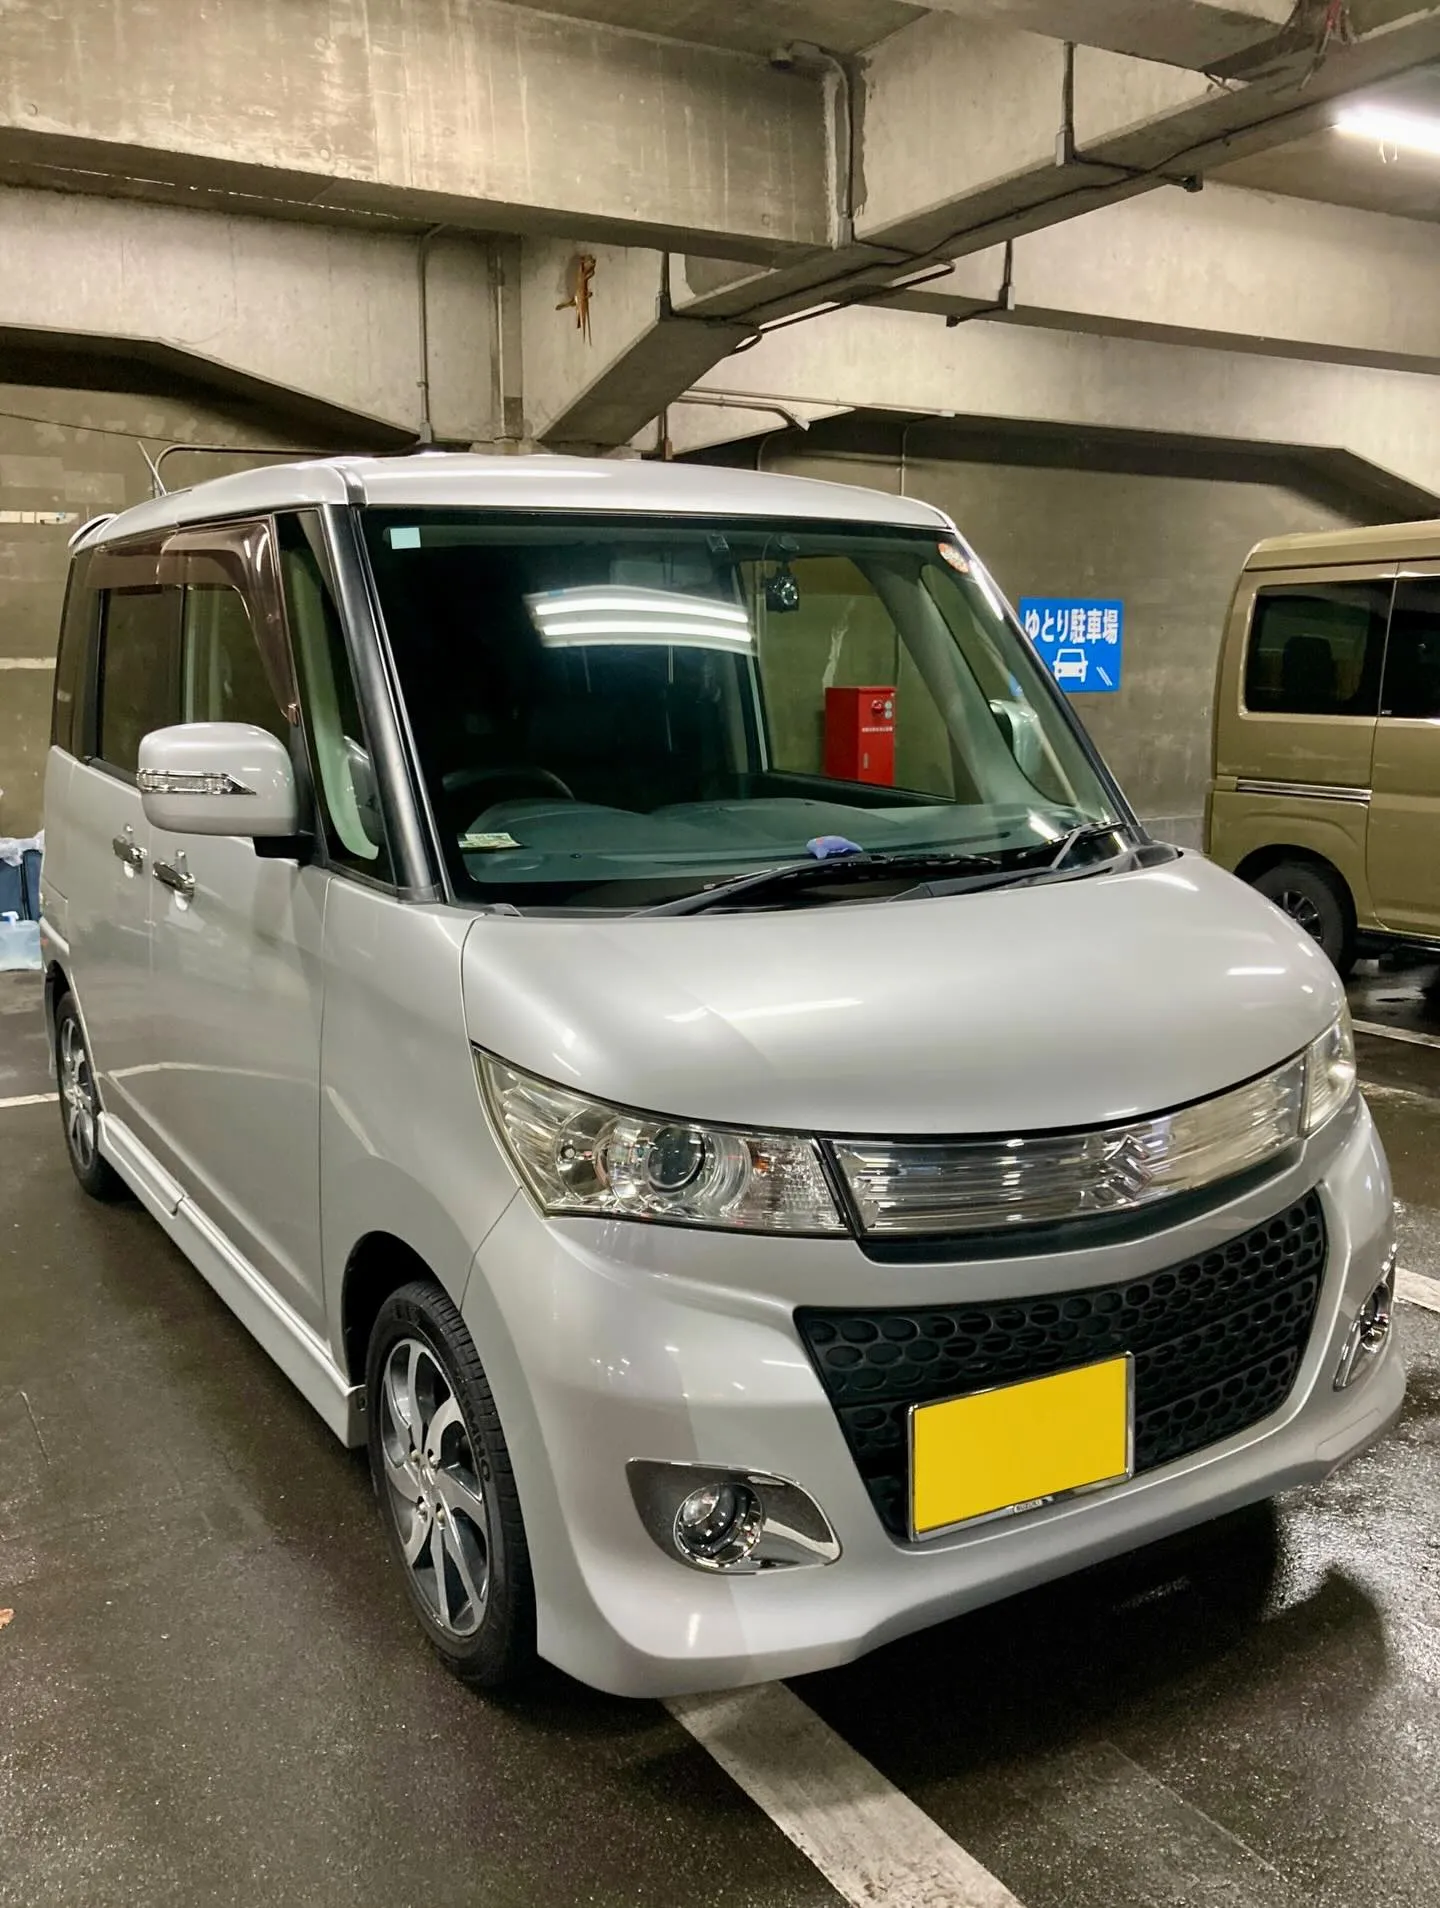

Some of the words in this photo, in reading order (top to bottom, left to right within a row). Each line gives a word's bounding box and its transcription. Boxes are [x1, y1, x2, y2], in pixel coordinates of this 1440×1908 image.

[1024, 607, 1119, 645] ゆとり駐車場
